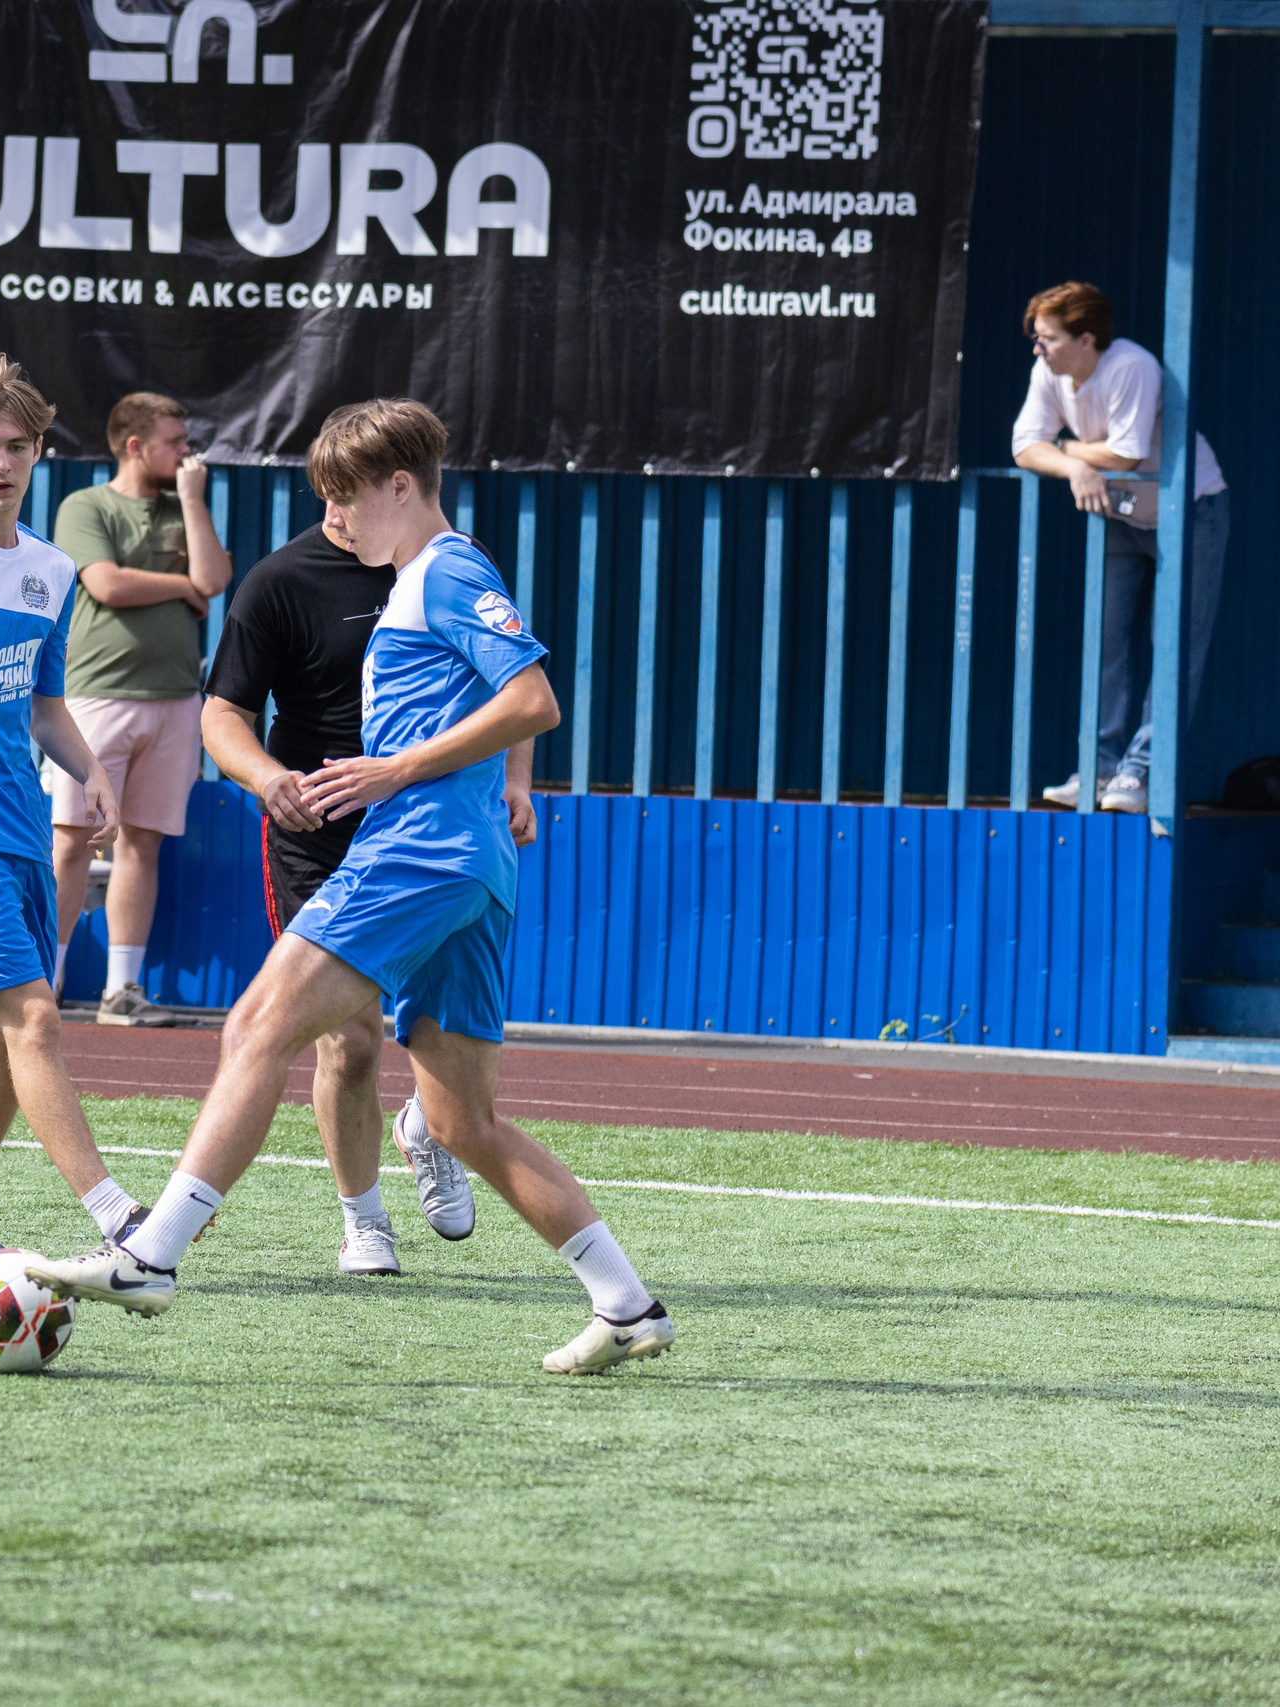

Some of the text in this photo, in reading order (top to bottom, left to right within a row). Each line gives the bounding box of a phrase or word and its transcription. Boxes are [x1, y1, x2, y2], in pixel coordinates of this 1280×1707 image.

[685, 184, 917, 222] ул. Адмирала
[684, 220, 825, 257] Фокина,
[155, 280, 174, 307] &
[188, 281, 433, 311] АКСЕССУАРЫ
[680, 283, 876, 317] culturavl.ru
